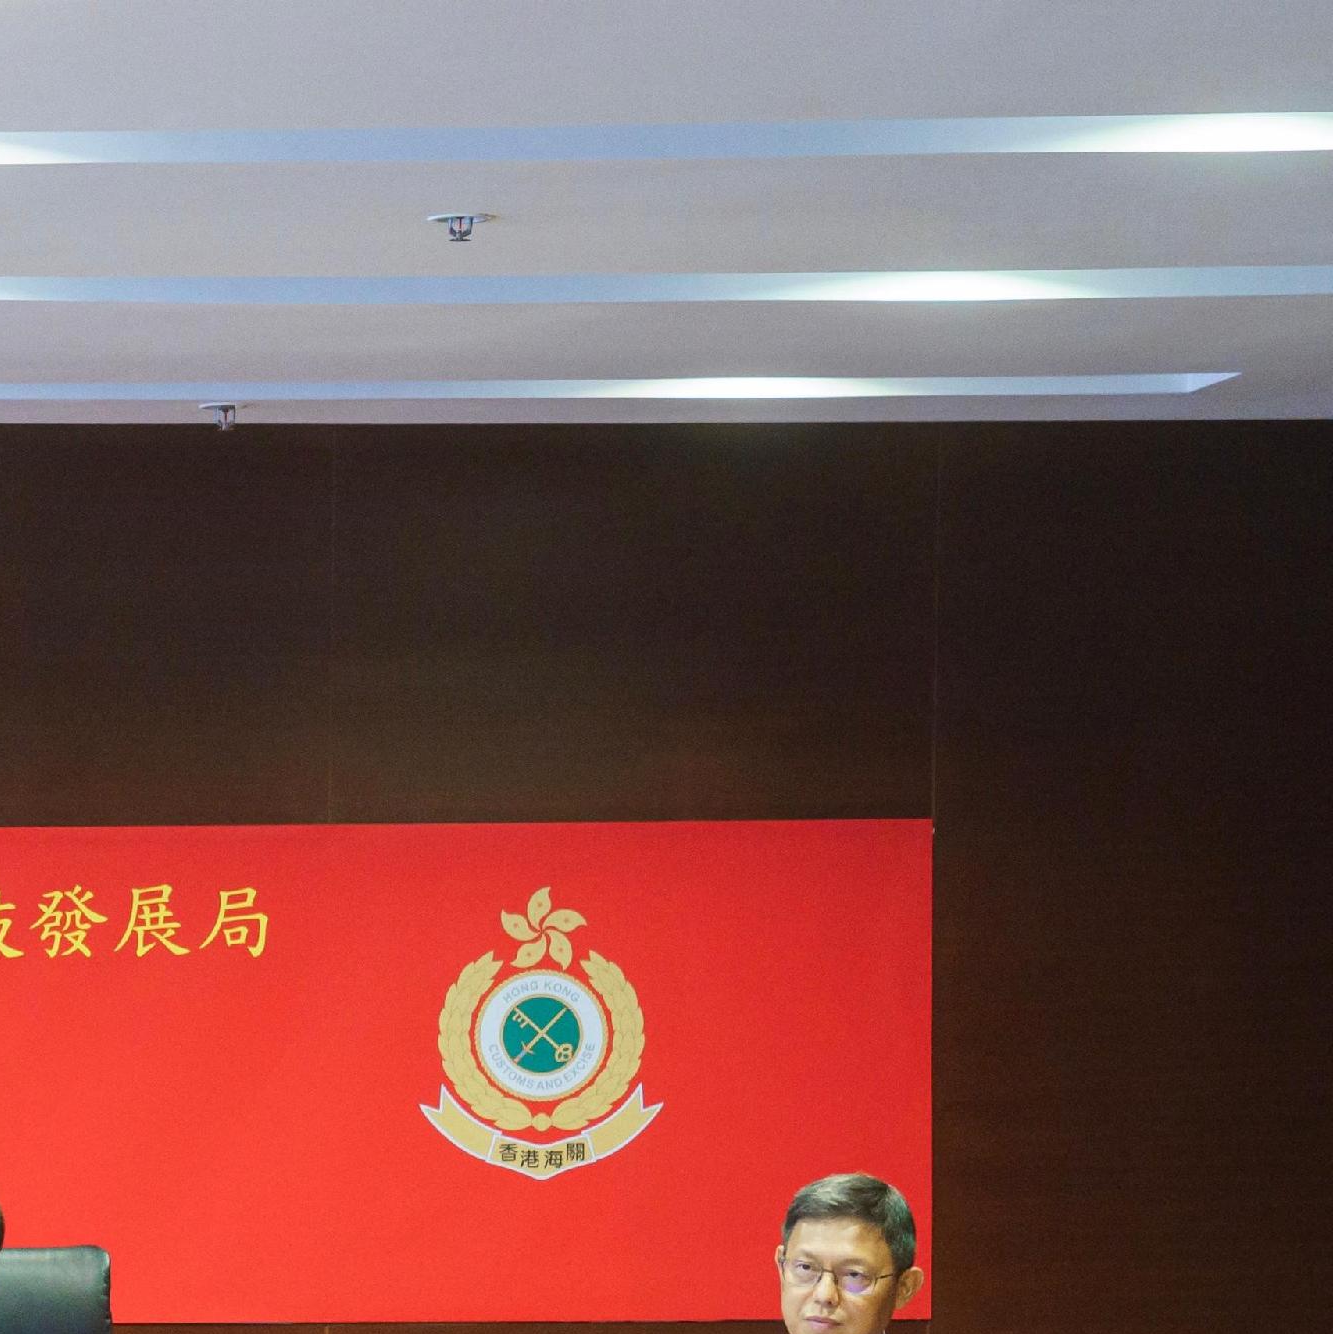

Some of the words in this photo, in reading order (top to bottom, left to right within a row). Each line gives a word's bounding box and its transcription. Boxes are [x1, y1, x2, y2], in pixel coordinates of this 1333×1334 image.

[501, 980, 539, 1004] HONG
[544, 980, 582, 1004] KONG
[487, 1043, 535, 1090] CUSTOMS
[536, 1078, 563, 1091] AND
[563, 1043, 596, 1083] EXCISE
[498, 1142, 586, 1170] 香港海關
